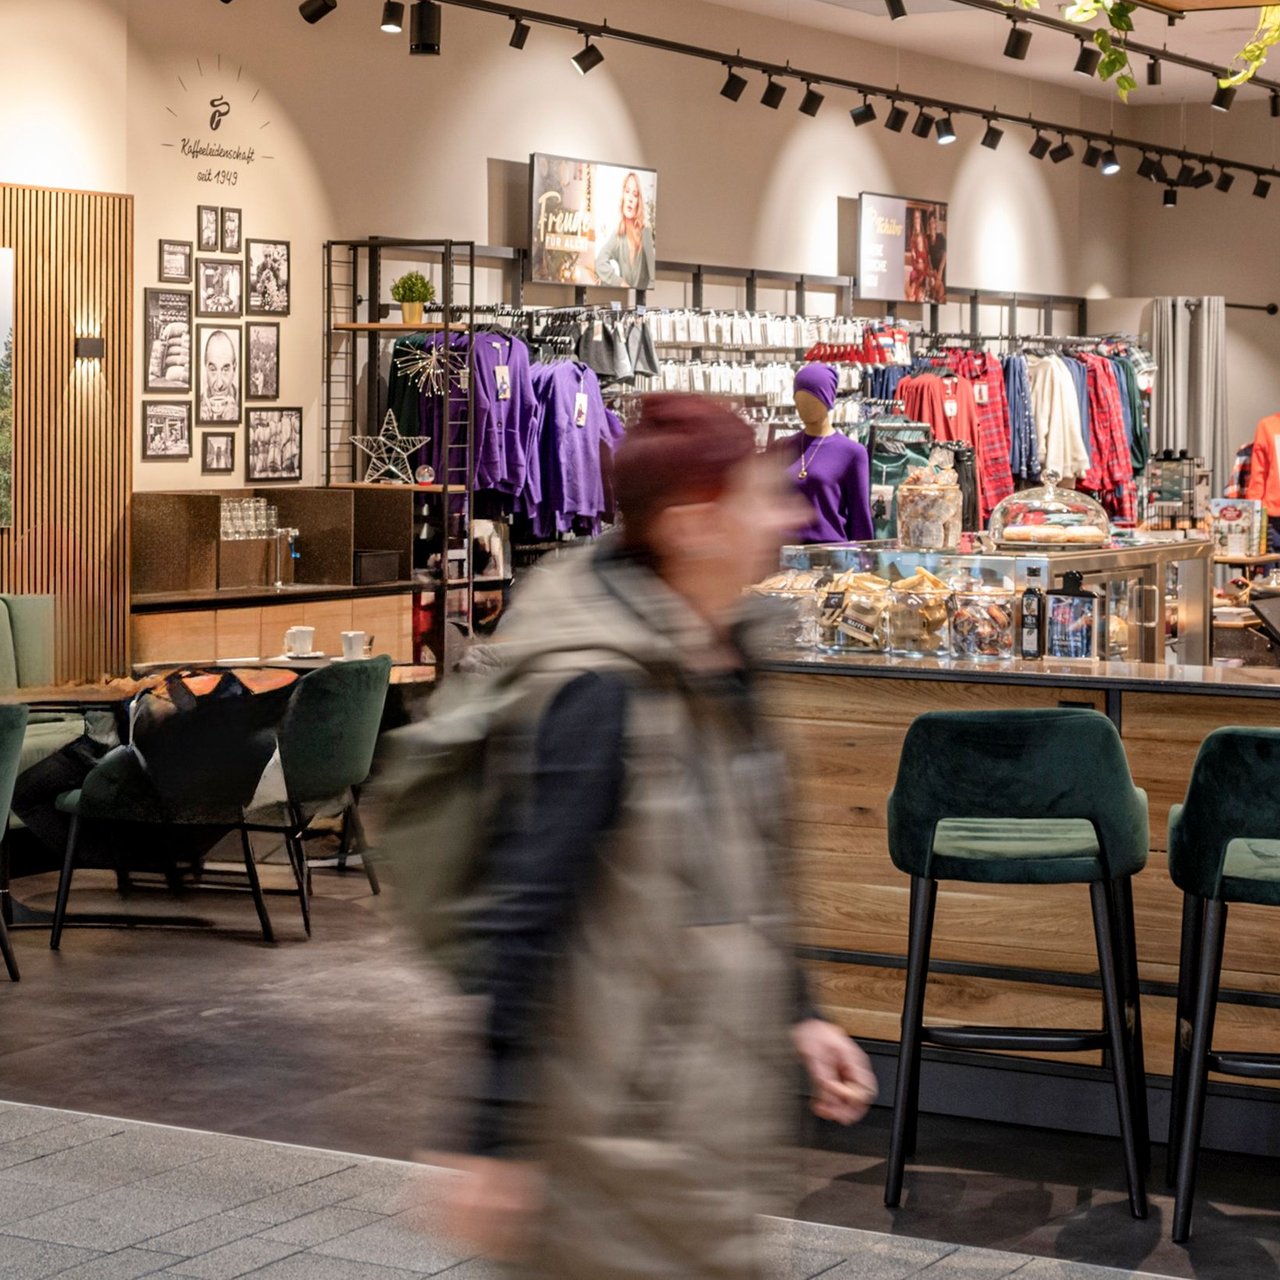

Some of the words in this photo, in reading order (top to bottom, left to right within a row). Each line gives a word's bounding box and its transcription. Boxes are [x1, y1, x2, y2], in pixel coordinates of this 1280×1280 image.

[181, 138, 255, 164] Kaffeeleidenschaft
[197, 168, 212, 182] seit
[214, 170, 238, 186] 1949
